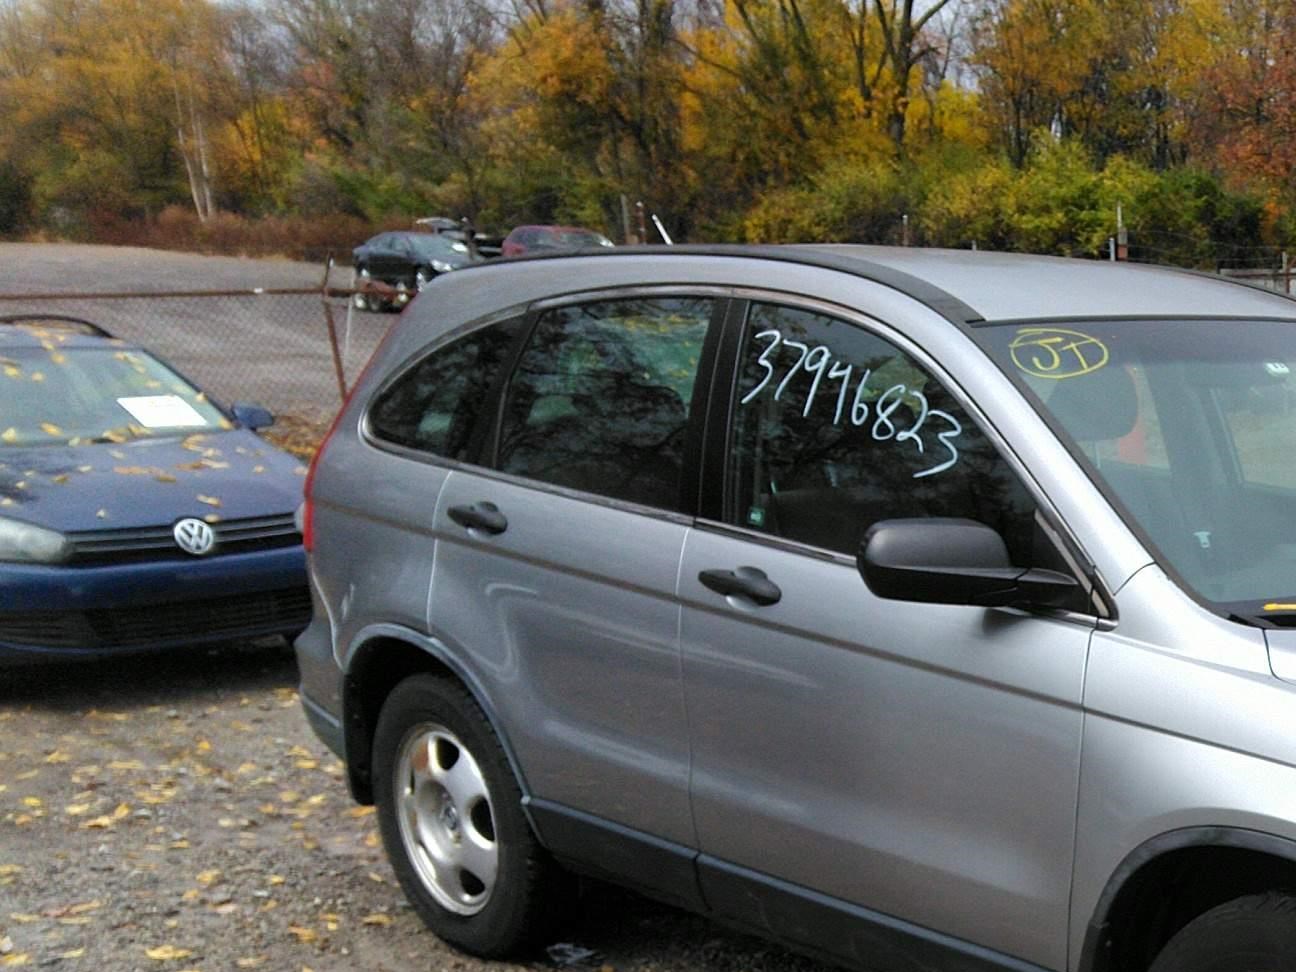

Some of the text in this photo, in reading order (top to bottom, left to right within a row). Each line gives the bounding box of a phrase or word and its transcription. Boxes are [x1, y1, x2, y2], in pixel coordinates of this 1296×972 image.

[1012, 336, 1096, 372] JT
[741, 329, 962, 478] 37946823
[174, 518, 214, 554] VW
